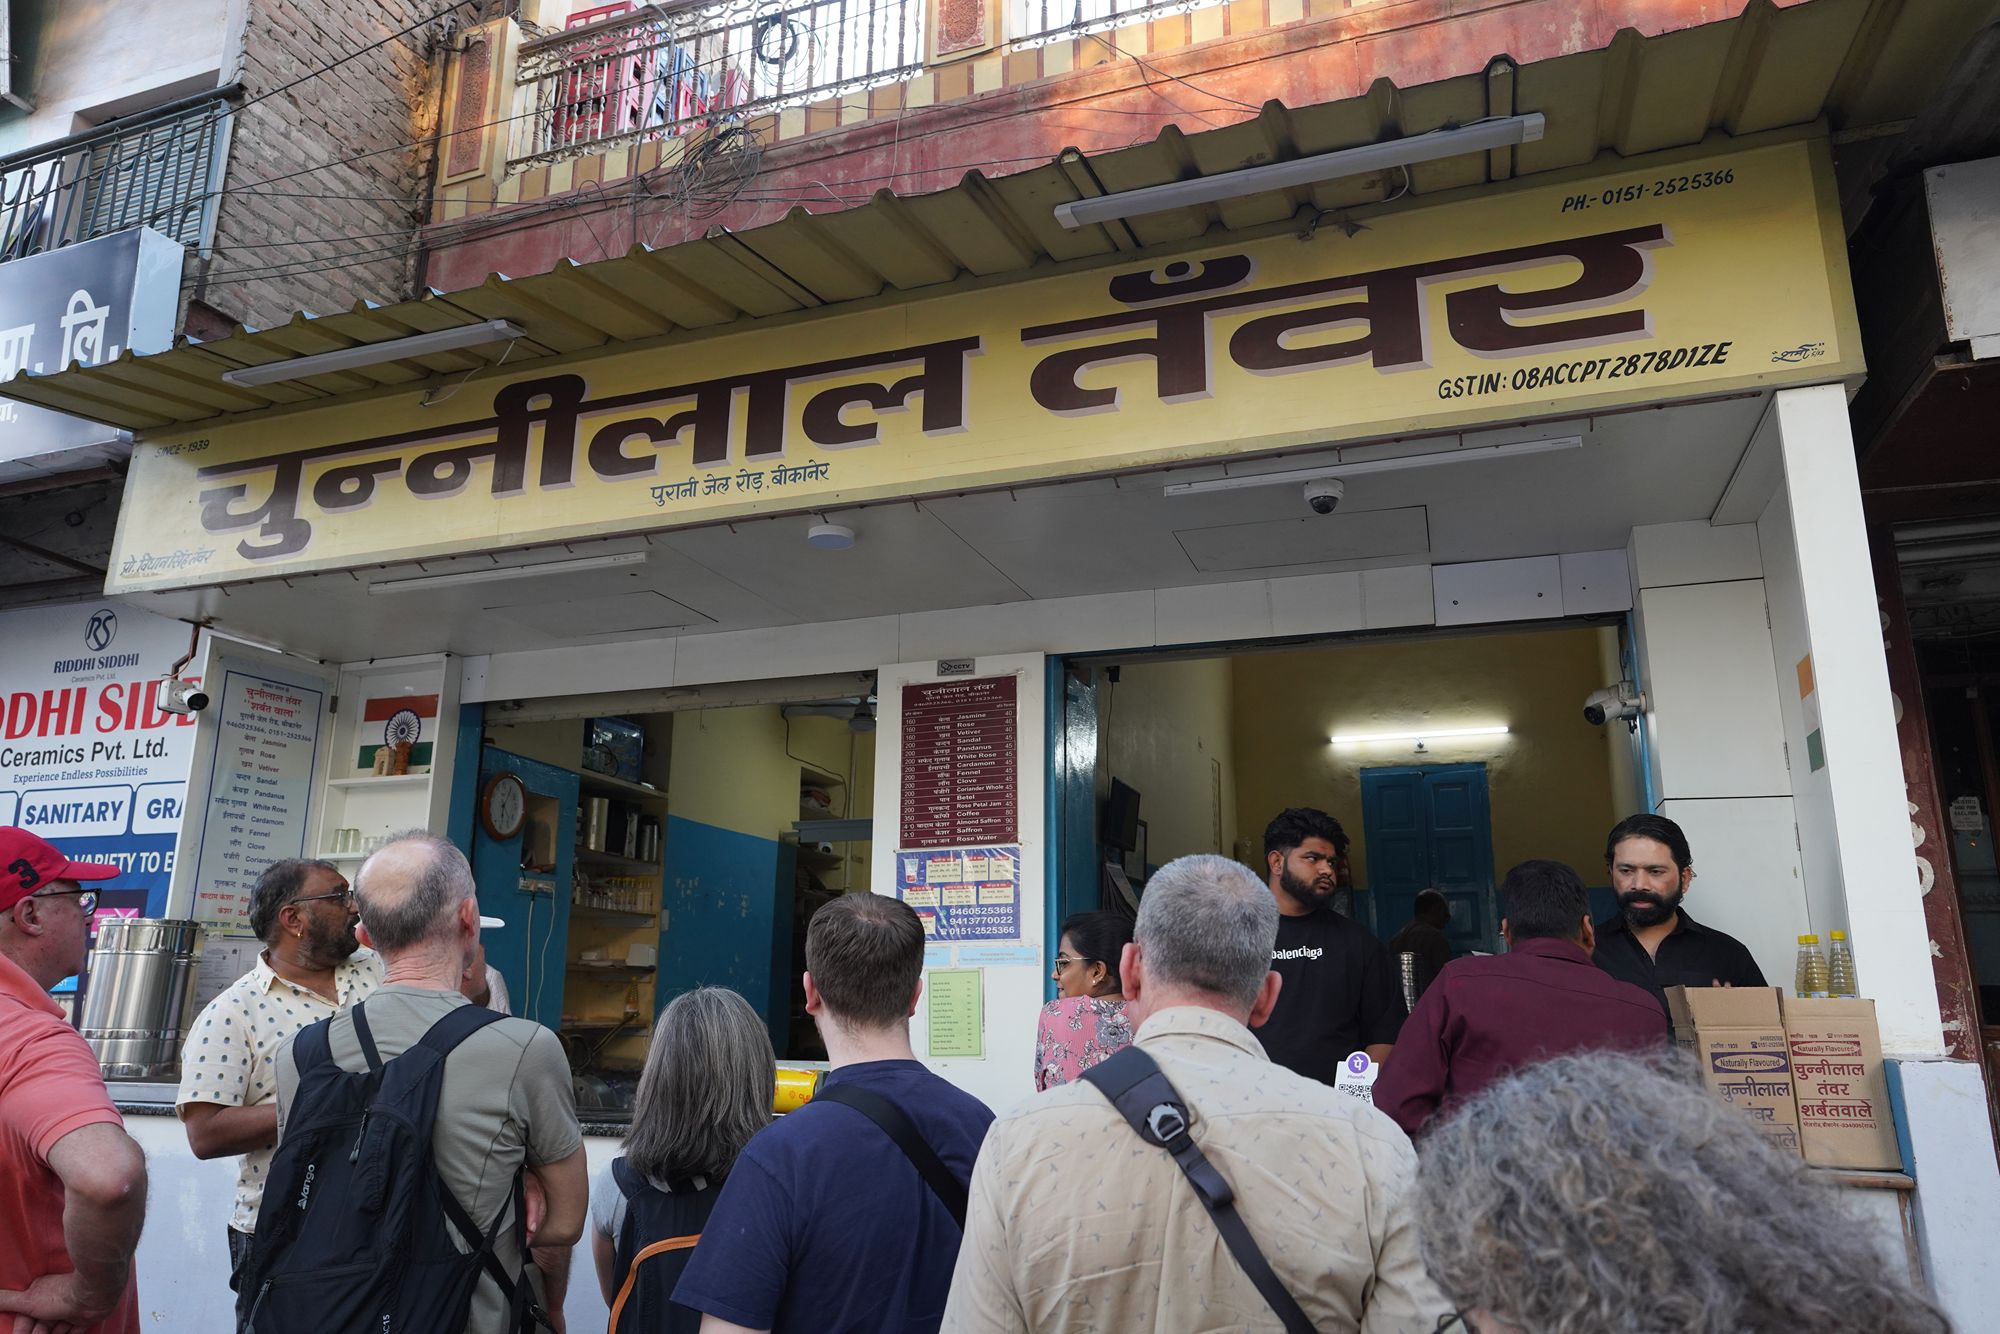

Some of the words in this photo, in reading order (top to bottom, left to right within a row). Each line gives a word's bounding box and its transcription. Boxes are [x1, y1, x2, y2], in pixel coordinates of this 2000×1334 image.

[1602, 168, 1735, 206] 0151-2525366
[60, 289, 119, 372] लि.
[1438, 371, 1508, 401] GSTIN:
[198, 336, 986, 564] चुन्नीलाल
[651, 475, 697, 506] पुरानी
[702, 471, 731, 497] जेल
[772, 459, 831, 487] बीकानेर
[53, 657, 96, 674] RIDDHI
[97, 653, 140, 670] SIDDHI
[0, 687, 87, 740] DHI
[262, 739, 287, 749] Jasmine
[957, 744, 992, 752] Pandanus
[0, 744, 84, 768] Ceramics
[91, 741, 125, 762] Pvt.
[133, 737, 169, 759] Ltd.
[260, 747, 276, 760] Rose
[258, 764, 280, 774] Vetiver
[957, 760, 996, 768] Cardamom
[13, 773, 60, 786] Experience
[61, 770, 94, 781] Endless
[95, 766, 148, 780] Possibilities
[256, 776, 278, 786] Sandal
[254, 789, 285, 801] Pandanus
[25, 799, 124, 826] SANITARY
[253, 802, 271, 812] White
[271, 805, 288, 814] Rose
[251, 816, 285, 827] Cardamom
[249, 829, 271, 838] Fennel
[247, 842, 266, 851] Clove
[140, 852, 160, 873] TO
[949, 907, 1013, 916] 9460525366
[949, 916, 1013, 925] 9413770022
[949, 926, 1015, 935] 0151-2525366
[1797, 1044, 1824, 1054] Naturally
[1825, 1044, 1854, 1053] Flavoured
[1720, 1058, 1748, 1070] Naturally
[1749, 1057, 1780, 1067] Flavoured
[1794, 1059, 1865, 1080] चुन्नीलाल
[1718, 1075, 1791, 1102] चुन्नीलाल
[1817, 1080, 1850, 1096] तंवर
[1801, 1101, 1873, 1118] शर्बतवाले
